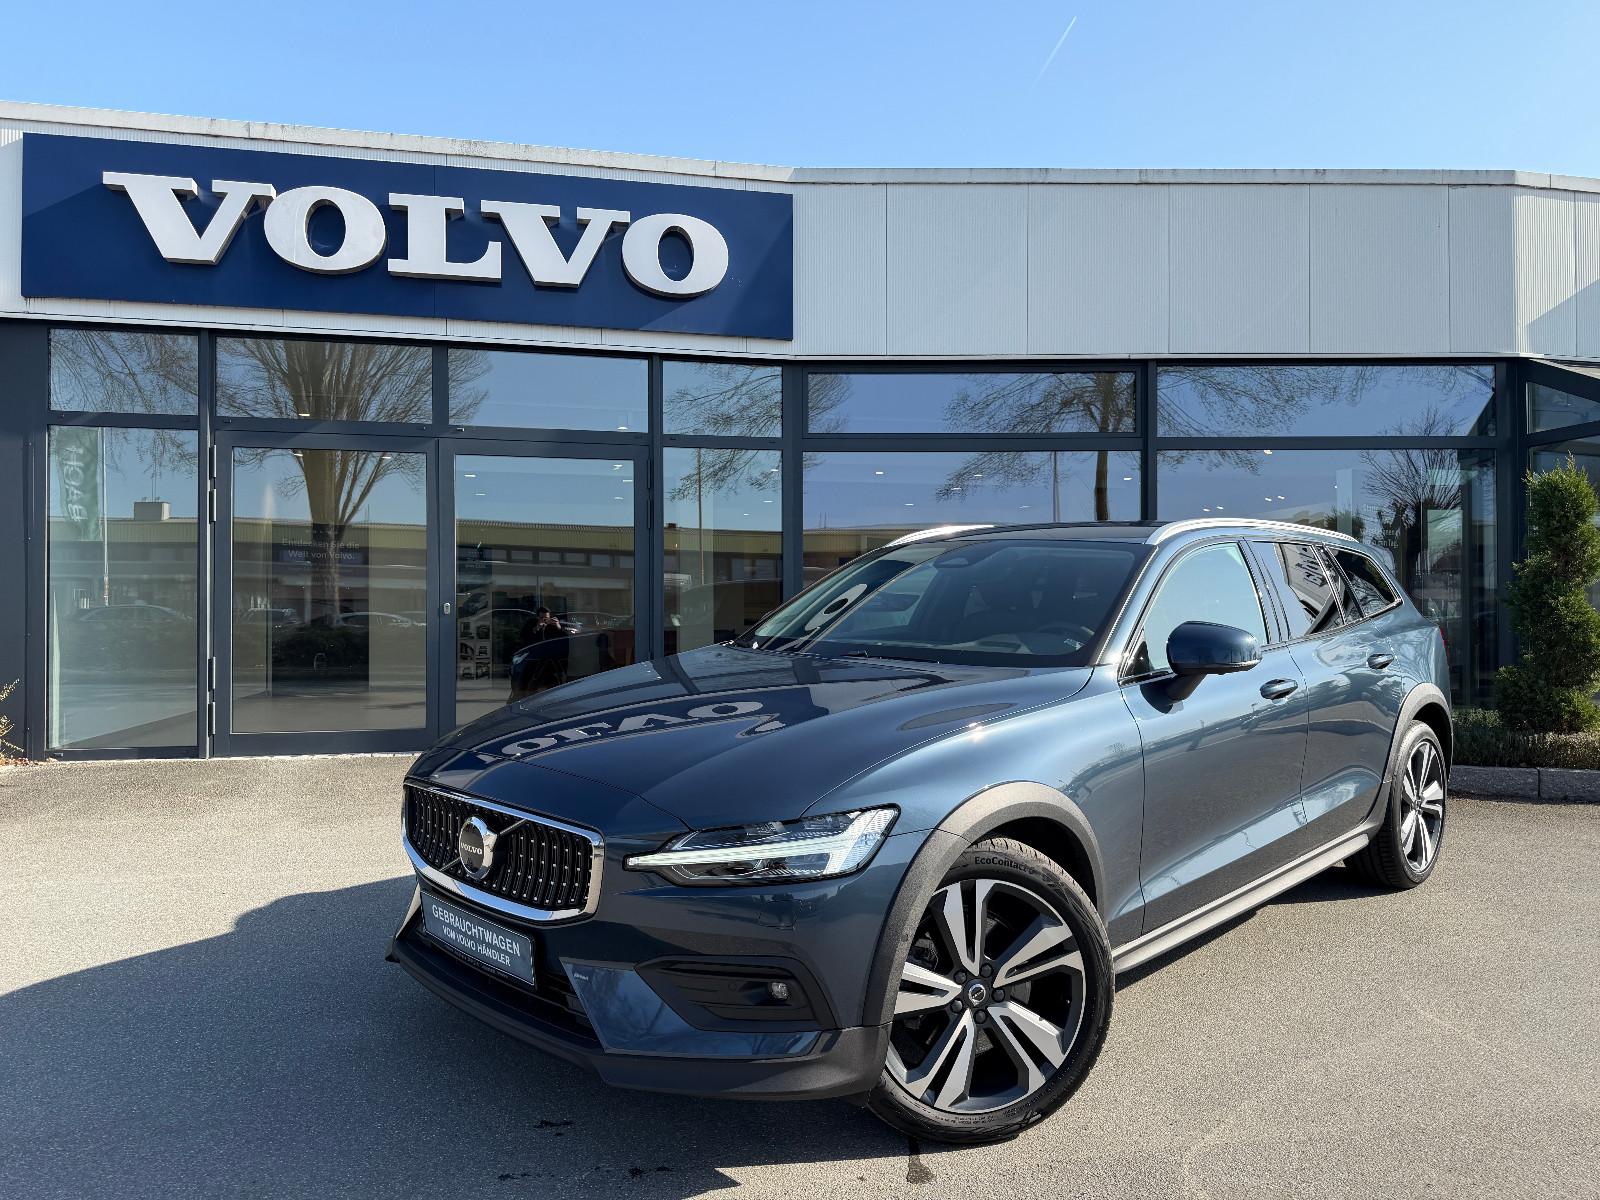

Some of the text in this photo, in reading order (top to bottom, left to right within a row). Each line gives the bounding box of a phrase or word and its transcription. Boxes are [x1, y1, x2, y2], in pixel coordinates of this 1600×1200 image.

[102, 171, 729, 298] VOLVO
[288, 549, 308, 558] Welt
[311, 552, 326, 560] von
[460, 842, 483, 855] VOLVO
[974, 856, 1028, 872] EcoContact
[432, 904, 521, 957] GEBRAUCHTWAGEN
[443, 925, 456, 940] VOM
[456, 932, 476, 951] VOLVO
[477, 943, 511, 967] HÄNDLER
